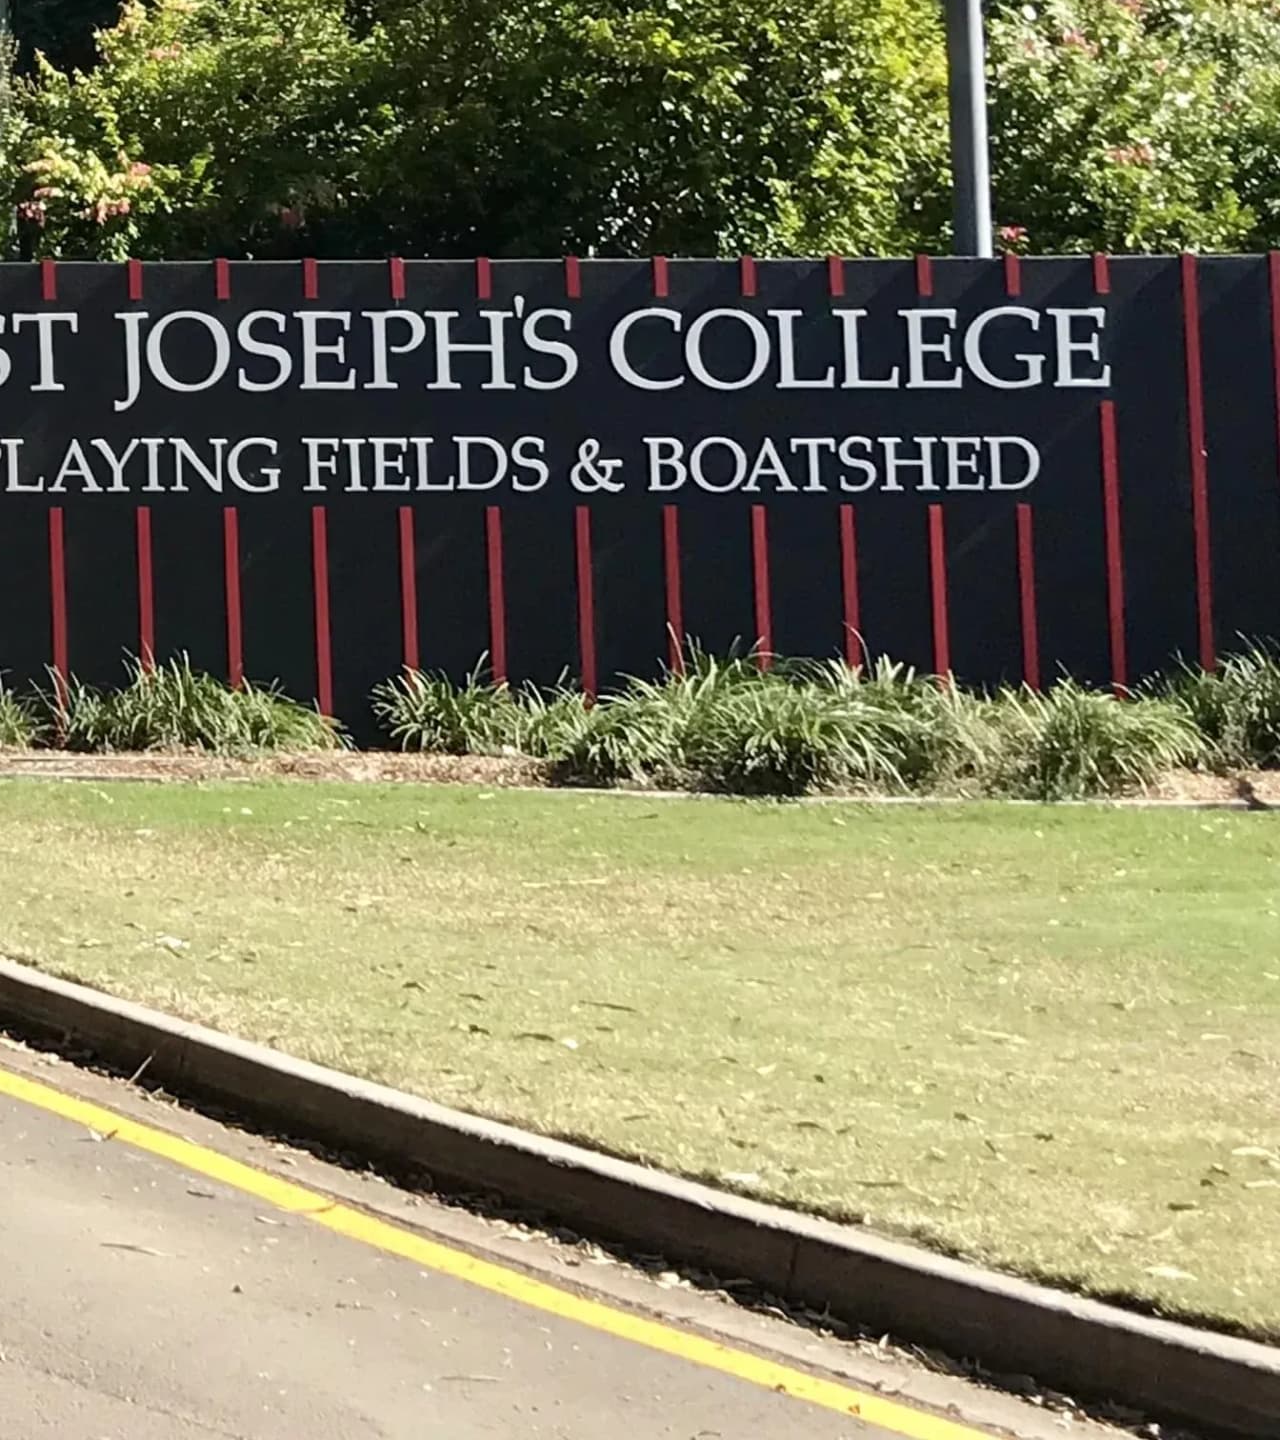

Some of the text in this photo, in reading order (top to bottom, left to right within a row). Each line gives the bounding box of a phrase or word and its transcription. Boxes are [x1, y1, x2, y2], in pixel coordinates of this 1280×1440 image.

[113, 295, 578, 412] JOSEPH'S
[609, 306, 1112, 390] COLLEGE
[301, 436, 550, 493] FIELDS
[570, 437, 625, 493] &
[642, 436, 1040, 492] BOATSHED
